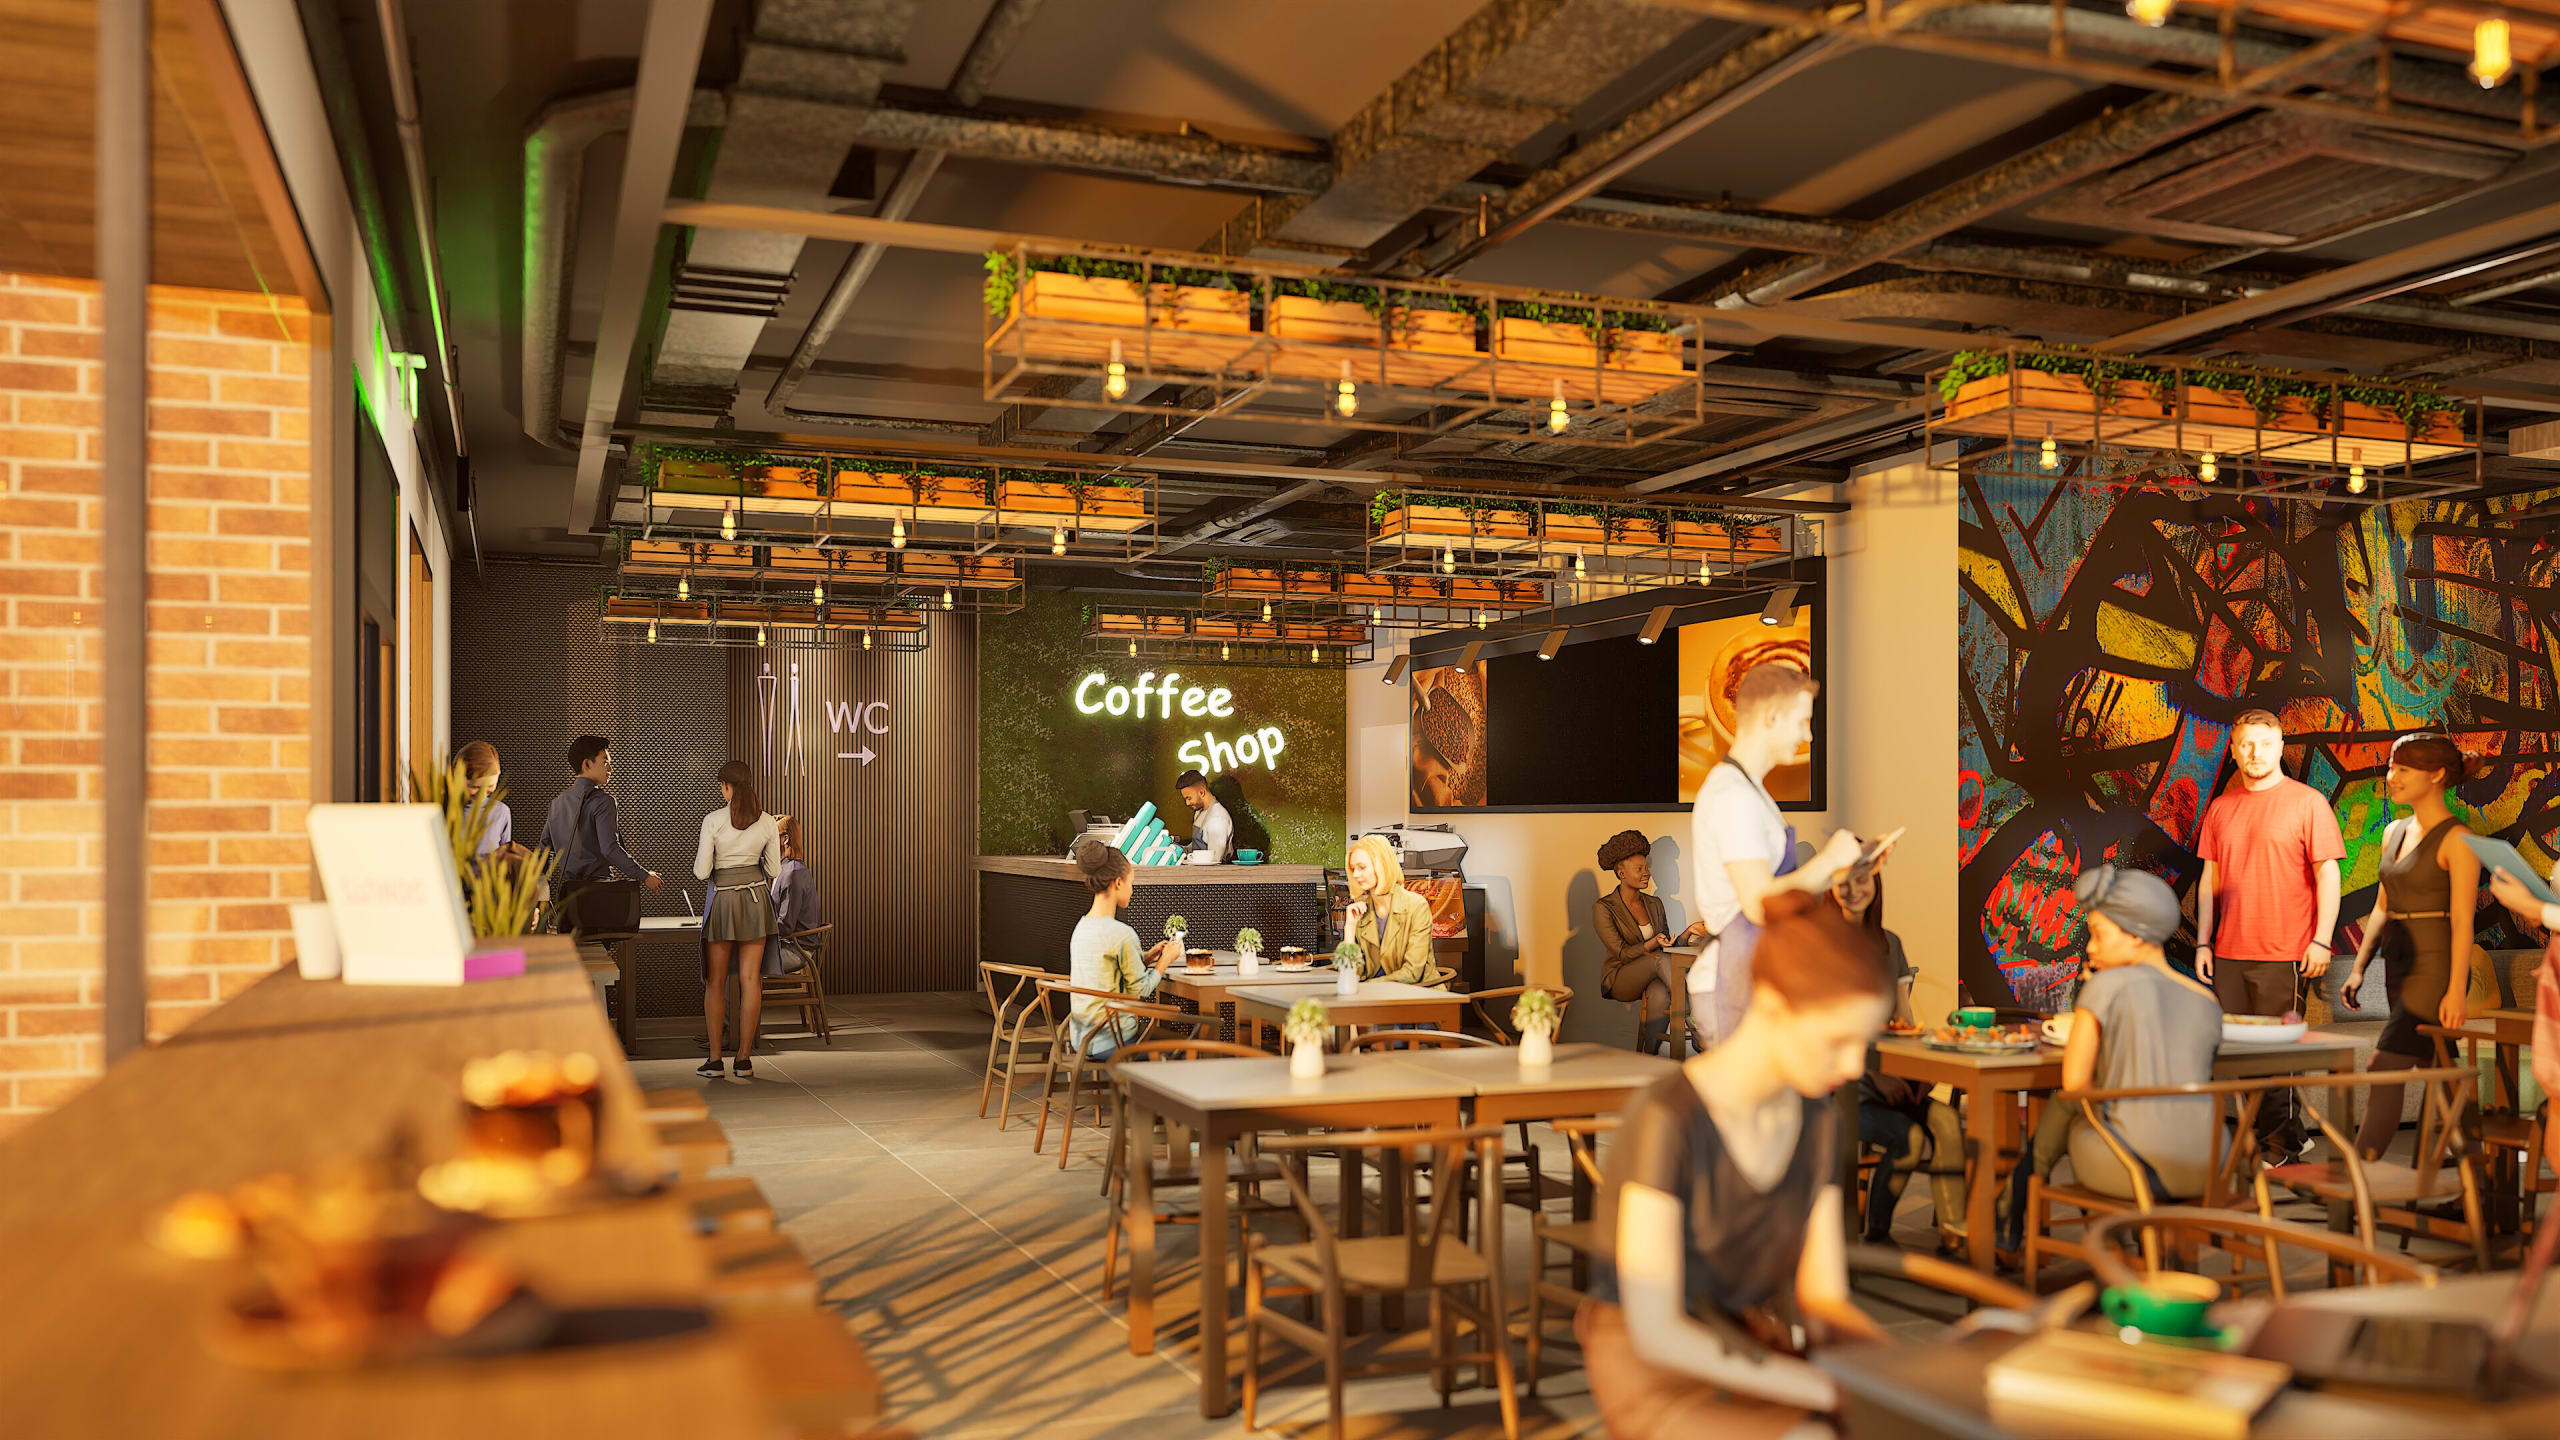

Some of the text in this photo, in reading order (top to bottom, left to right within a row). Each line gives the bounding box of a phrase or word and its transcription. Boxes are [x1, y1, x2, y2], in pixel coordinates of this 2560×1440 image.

[825, 701, 889, 735] WC
[1074, 671, 1235, 719] Coffee
[1177, 726, 1285, 778] Shop
